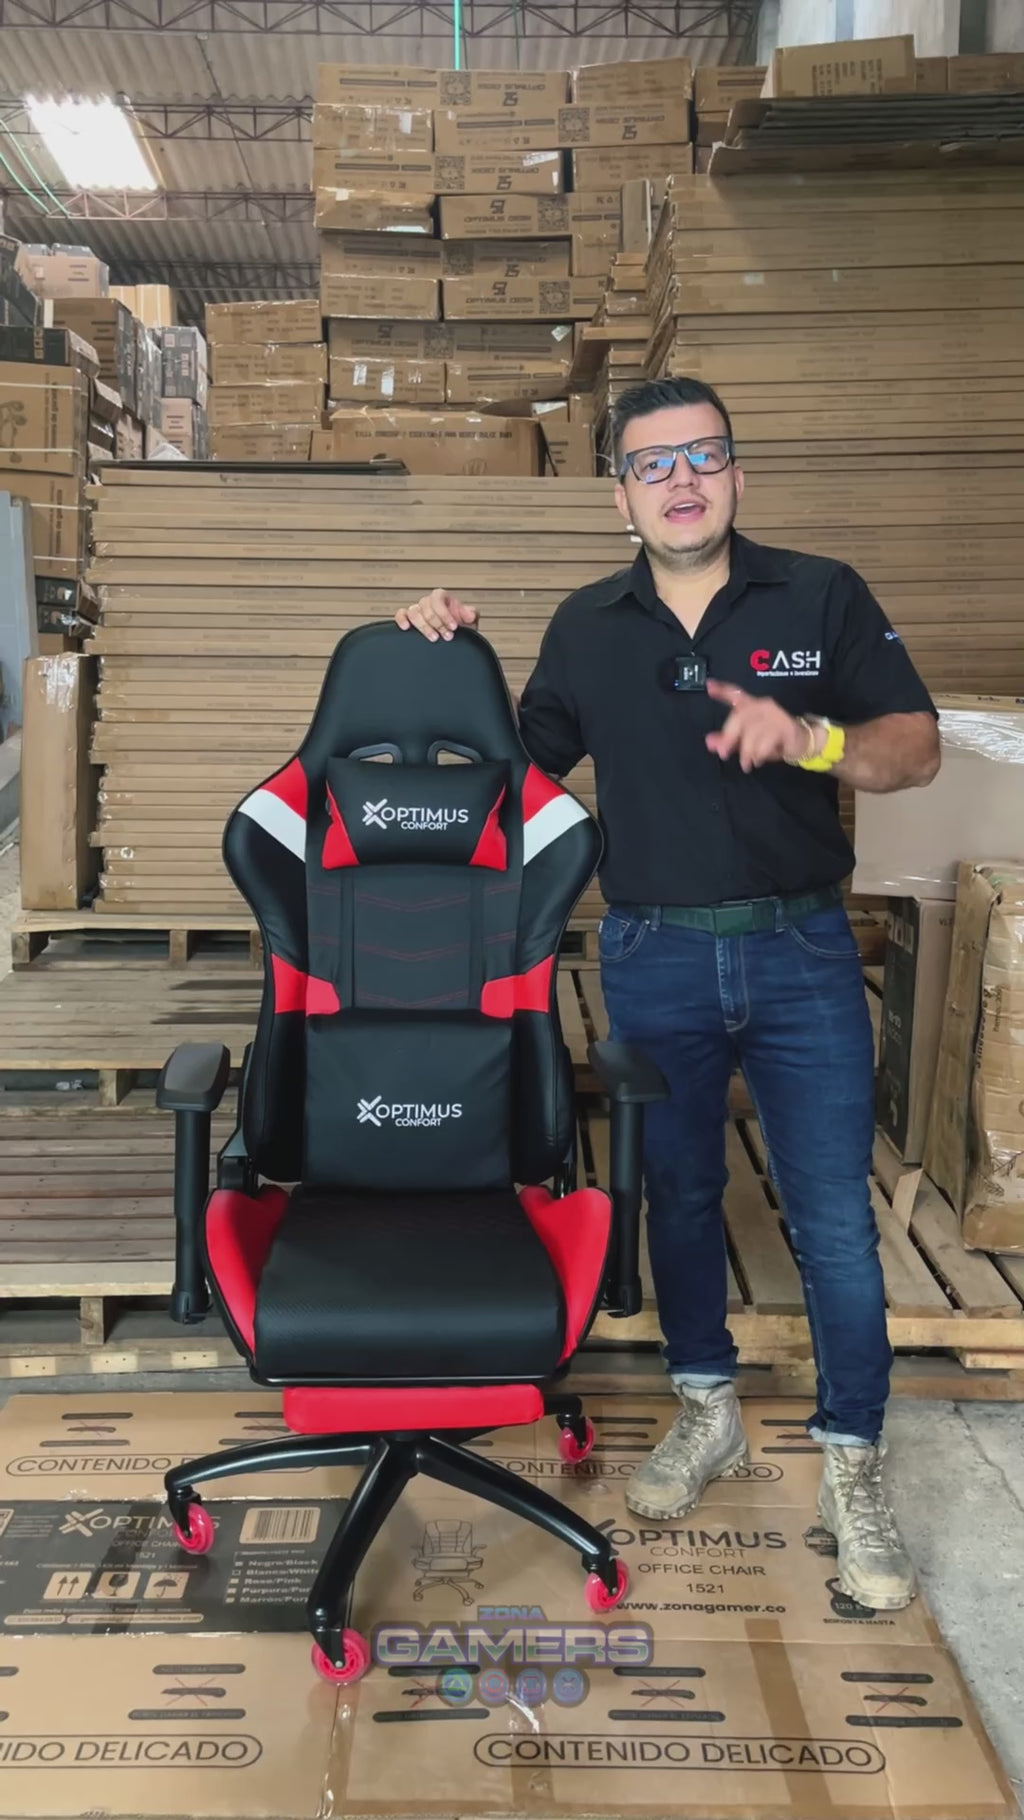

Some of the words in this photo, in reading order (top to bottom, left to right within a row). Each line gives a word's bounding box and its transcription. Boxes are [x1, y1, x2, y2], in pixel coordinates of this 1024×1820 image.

[750, 649, 821, 670] CASH
[380, 806, 469, 824] OPTIMUS
[400, 821, 449, 831] CONFORT
[375, 1103, 463, 1119] OPTIMUS
[394, 1117, 442, 1127] CONFORT
[16, 1456, 172, 1473] CONTENIDO
[89, 1515, 221, 1530] OPTIMS
[610, 1528, 787, 1549] OPTIMUS
[650, 1546, 746, 1558] CONFORT
[637, 1563, 704, 1574] OFFICE
[709, 1564, 766, 1576] CHAIR
[686, 1583, 725, 1594] 1521
[616, 1601, 786, 1614] www.zonagamer.co
[834, 1602, 853, 1610] 120
[74, 1740, 249, 1762] DELICADO
[487, 1738, 690, 1763] CONTENIDO
[702, 1742, 872, 1768] DELICADO
